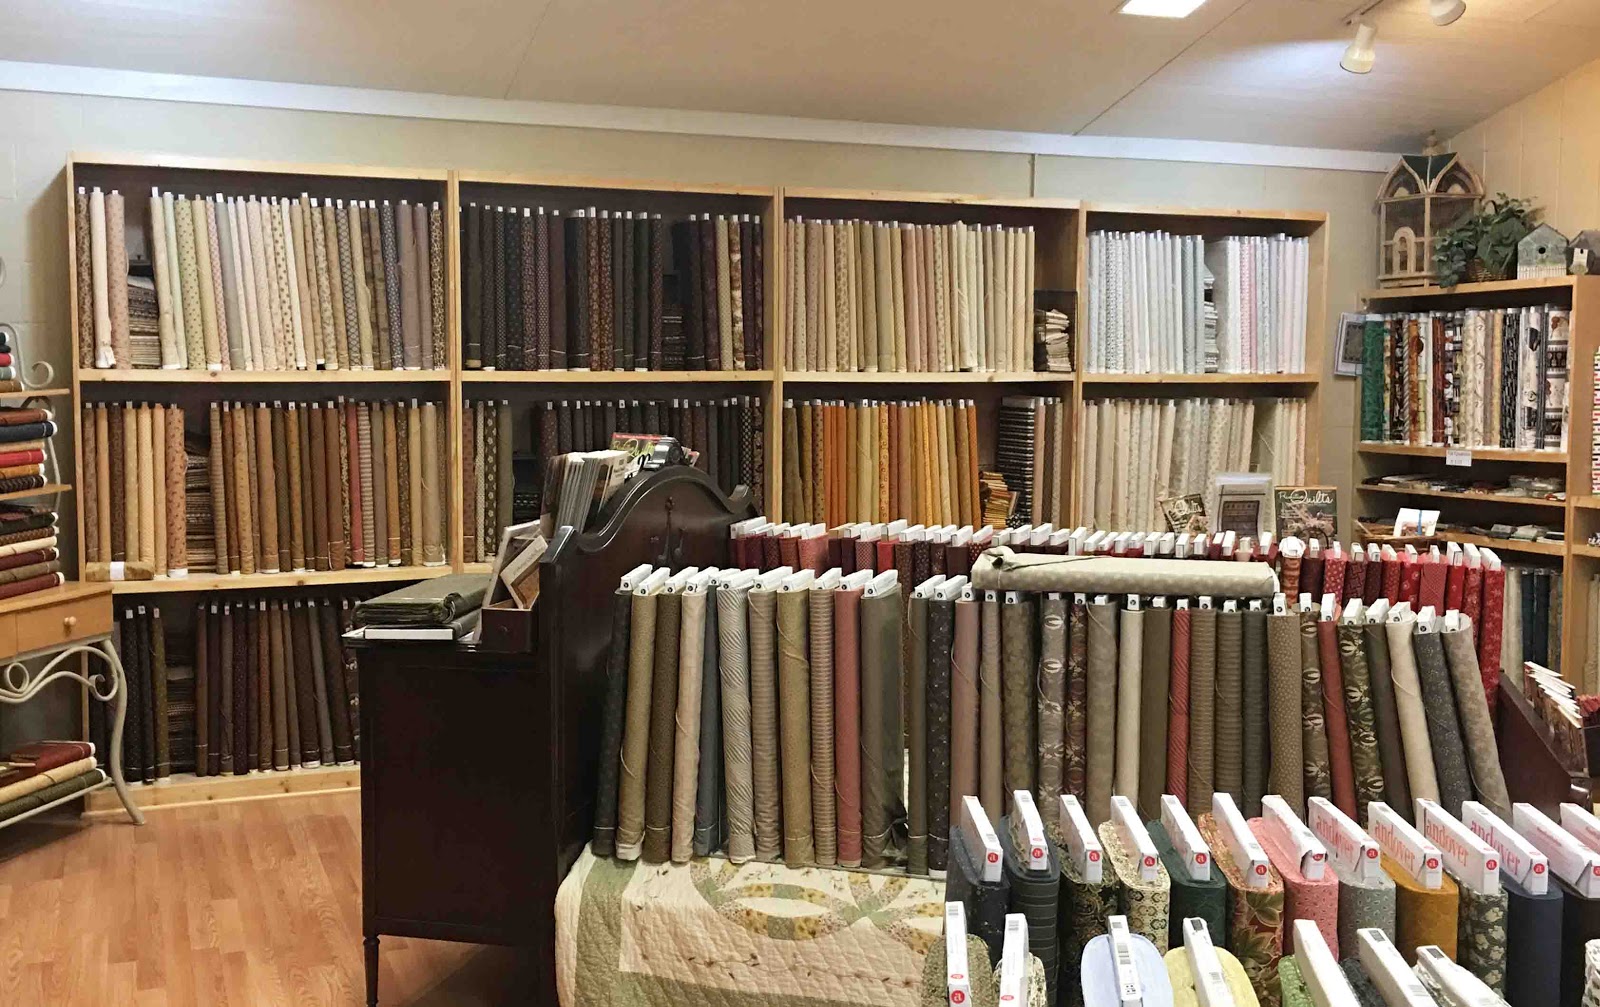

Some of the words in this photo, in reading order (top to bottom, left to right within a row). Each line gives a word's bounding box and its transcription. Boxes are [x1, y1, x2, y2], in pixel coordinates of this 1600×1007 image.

[1290, 488, 1334, 505] Quilts
[1316, 815, 1354, 863] andover
[1374, 820, 1416, 872] andover
[1426, 820, 1469, 867] andover
[1470, 820, 1521, 876] andover
